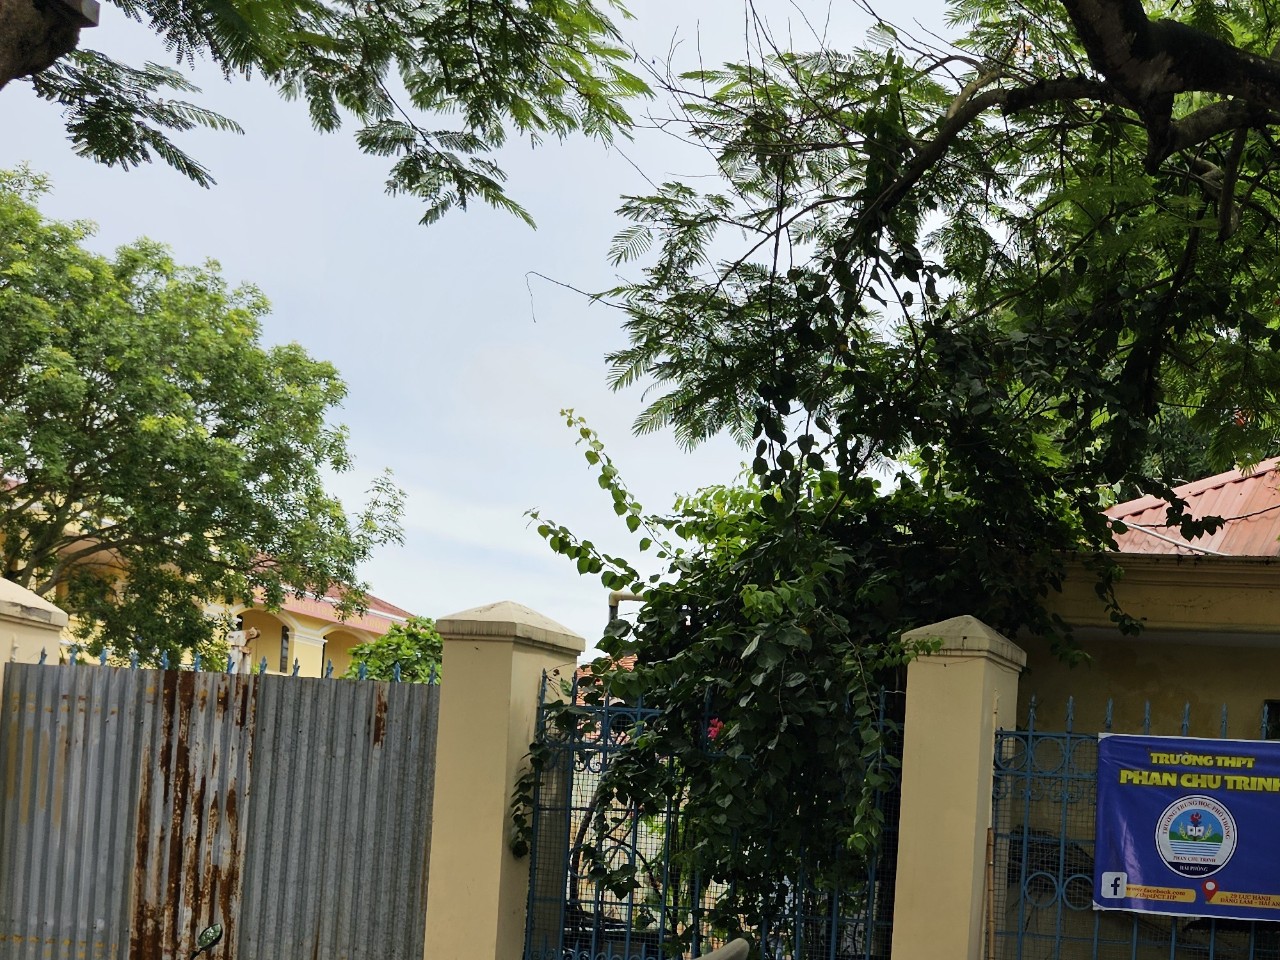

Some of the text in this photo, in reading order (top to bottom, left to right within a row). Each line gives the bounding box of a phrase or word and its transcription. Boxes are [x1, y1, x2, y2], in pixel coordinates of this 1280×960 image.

[1150, 751, 1255, 768] TRƯỜNG THPT
[1119, 769, 1177, 787] PHAN
[1180, 773, 1222, 789] CHU
